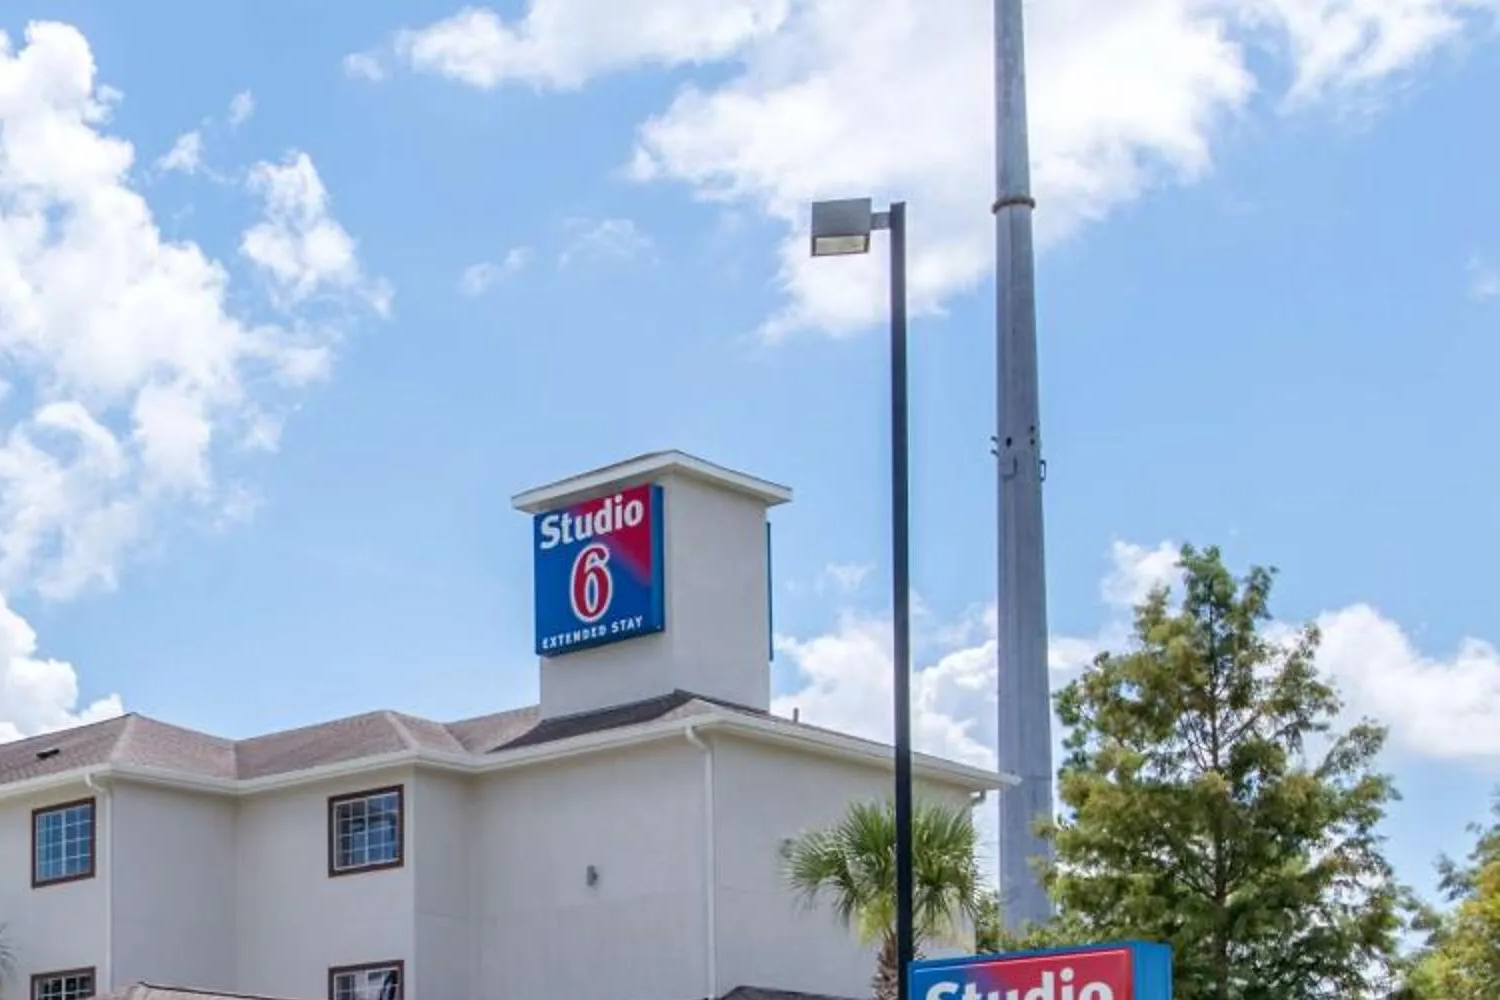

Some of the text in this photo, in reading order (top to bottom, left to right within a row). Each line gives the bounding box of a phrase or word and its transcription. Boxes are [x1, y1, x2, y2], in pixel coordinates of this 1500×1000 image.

[540, 494, 644, 549] Studio
[570, 543, 613, 623] 6
[541, 615, 643, 649] EXTENDED STAY
